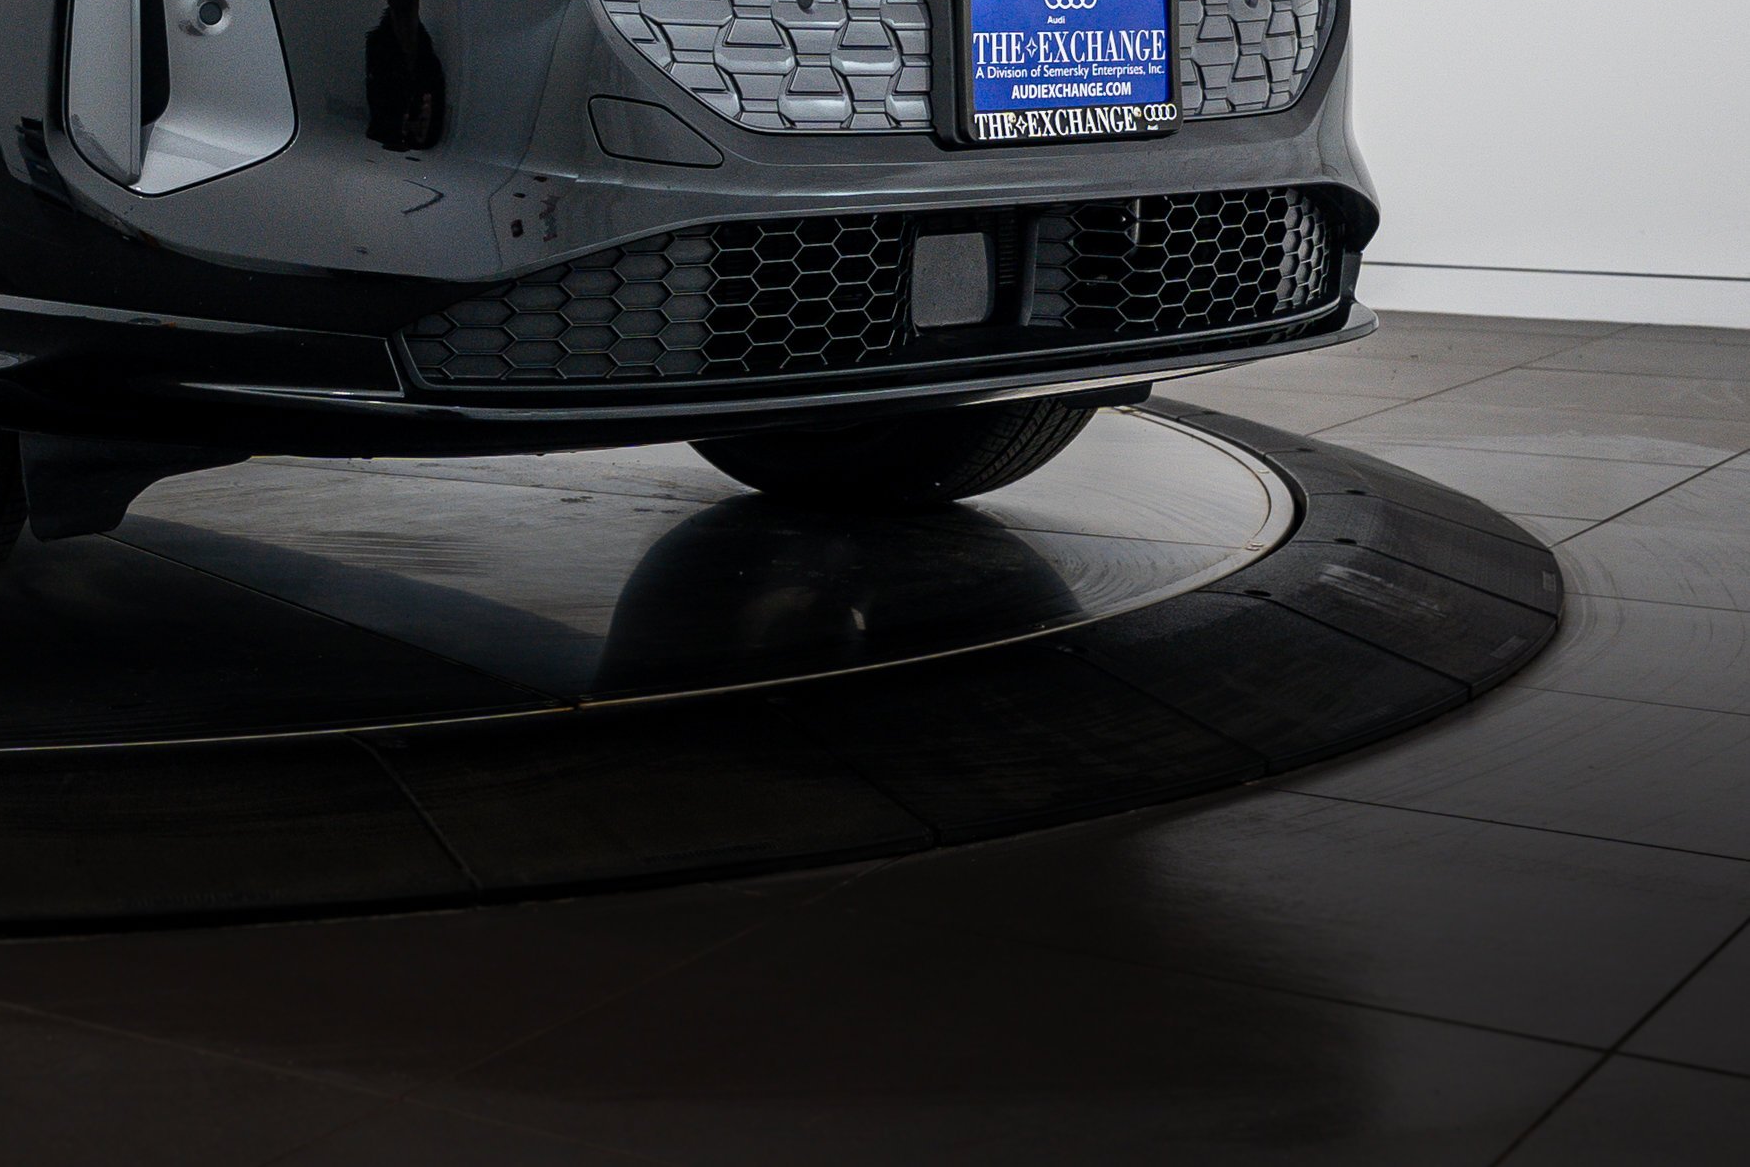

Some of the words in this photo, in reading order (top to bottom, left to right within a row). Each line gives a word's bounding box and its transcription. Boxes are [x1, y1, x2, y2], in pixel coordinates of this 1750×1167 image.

[1047, 15, 1065, 24] Audi
[973, 32, 1025, 65] THE
[1037, 29, 1166, 63] EXCHANGE
[975, 68, 984, 79] A
[987, 66, 1028, 79] Division
[1030, 65, 1041, 77] of
[1043, 65, 1089, 79] Semersky
[1092, 63, 1146, 78] Enterprises,
[1148, 63, 1165, 75] Inc.
[1011, 82, 1132, 100] AUDIEXCHANGE.COM
[974, 112, 1018, 140] THE
[1025, 106, 1137, 138] EXCHANGE
